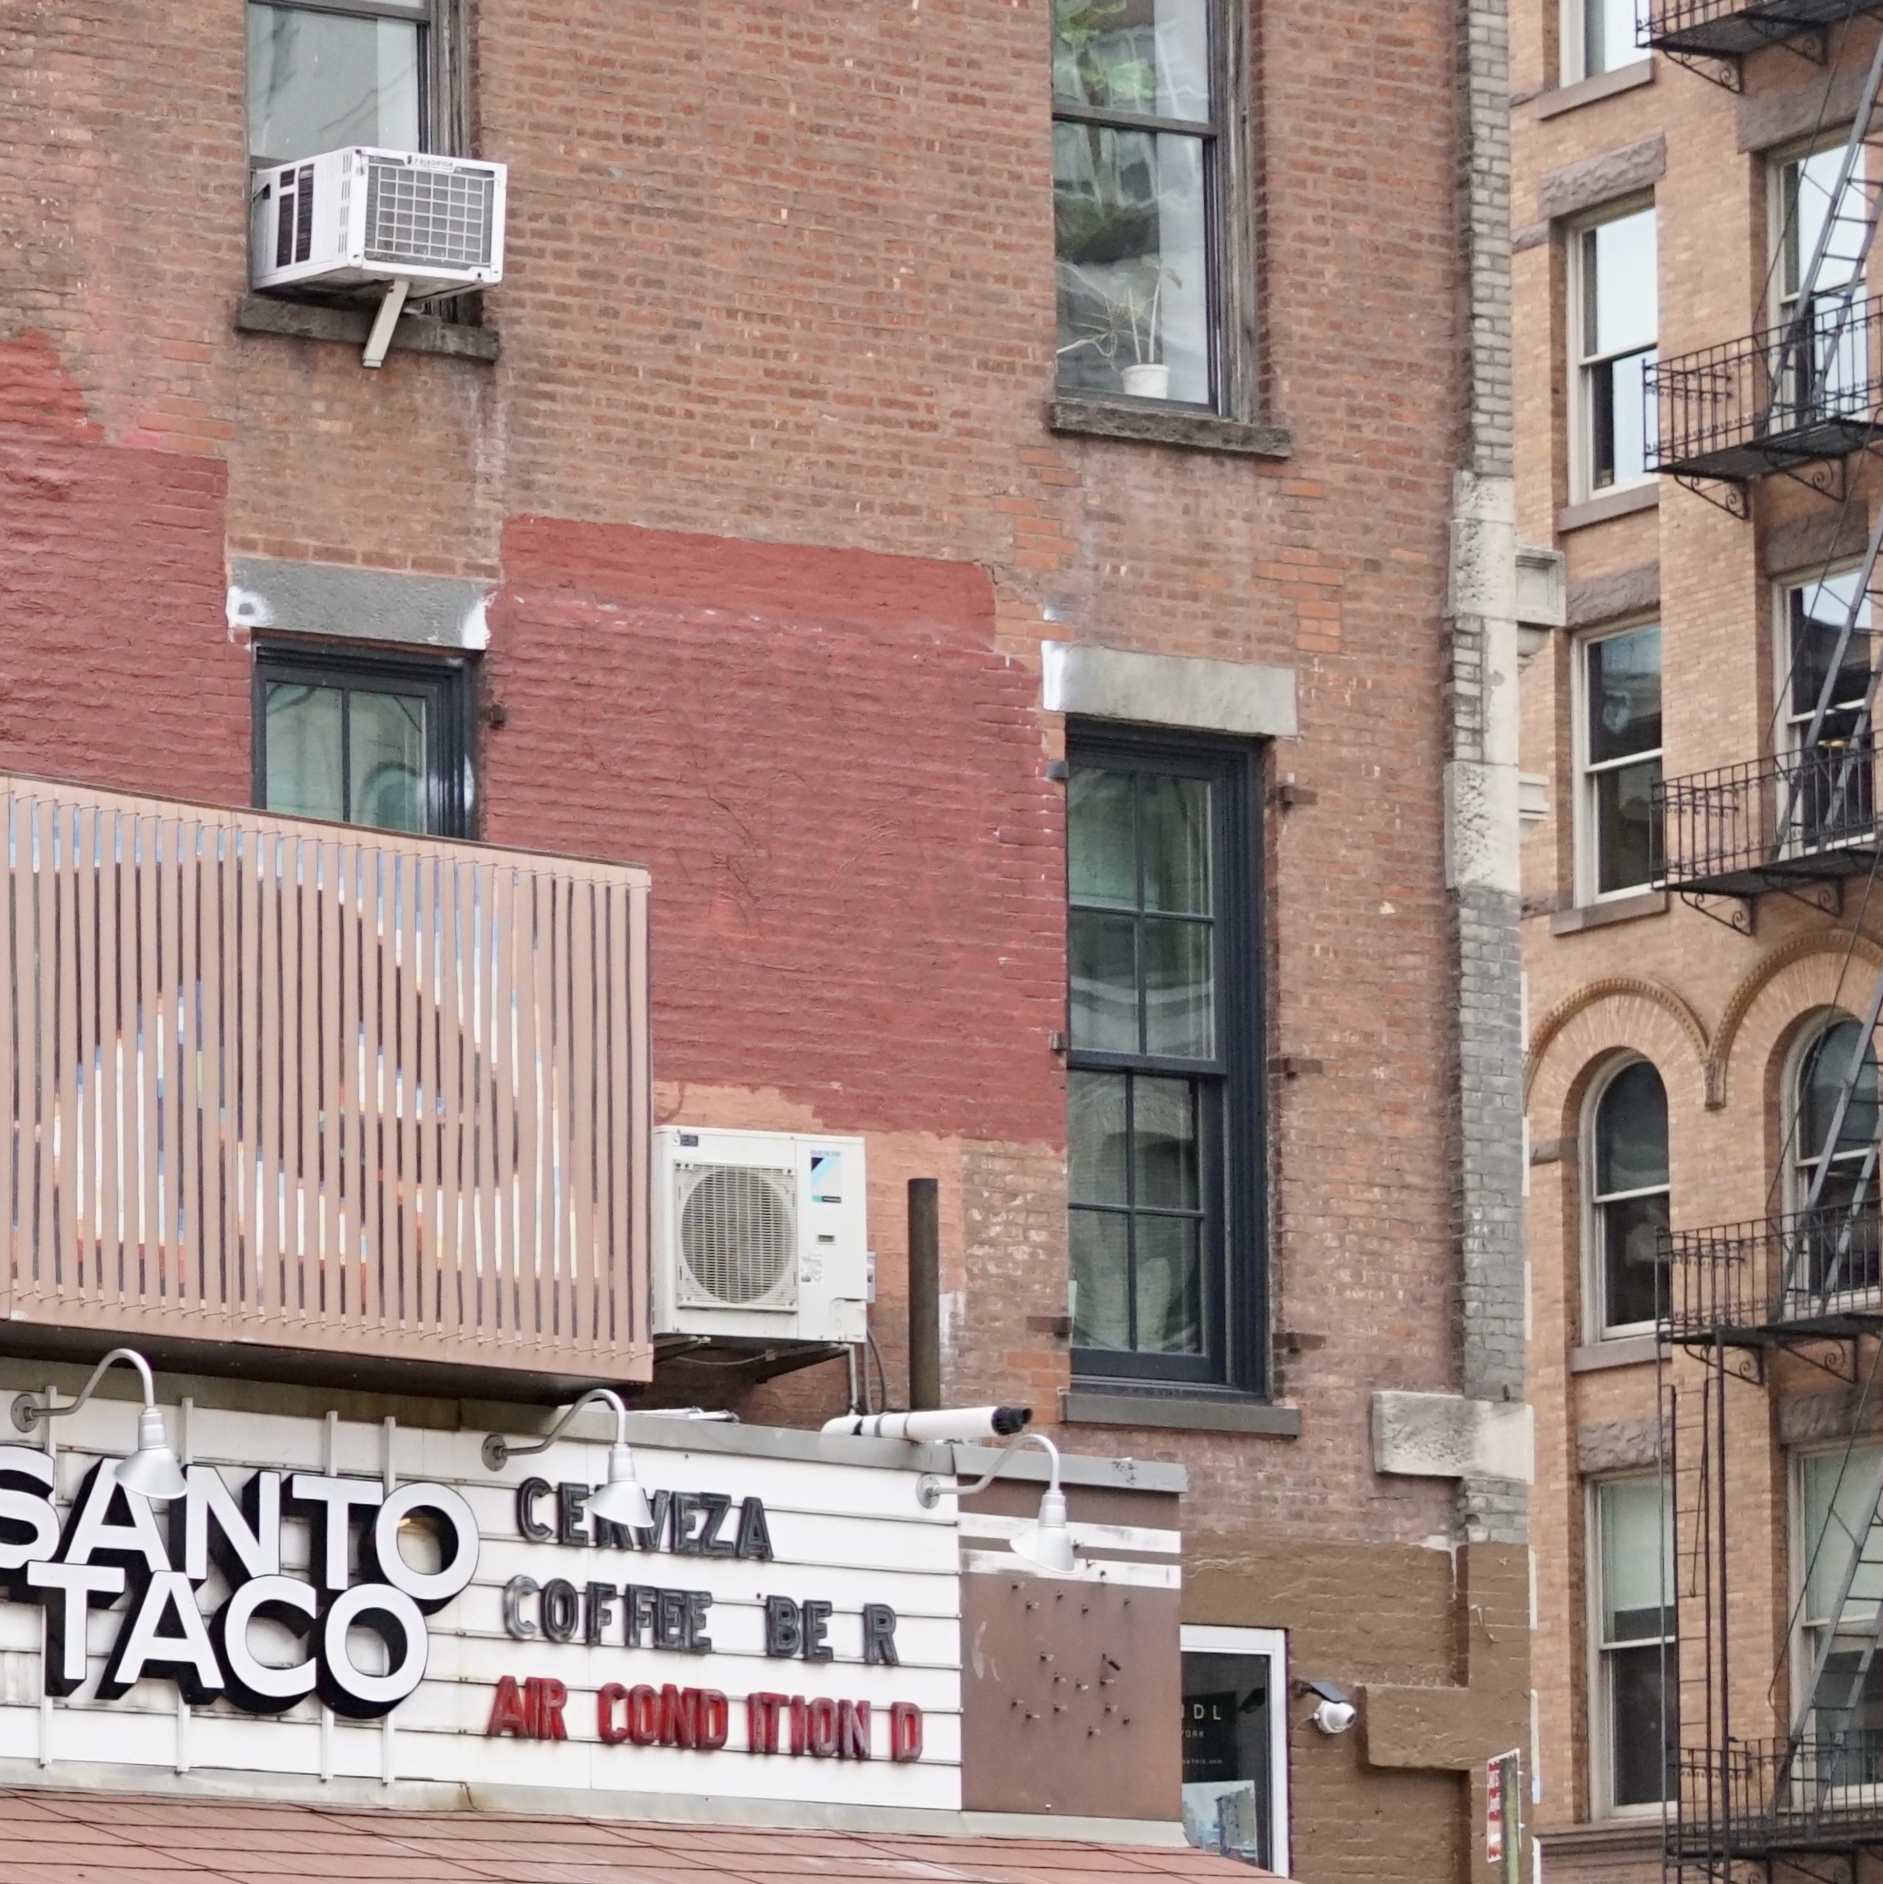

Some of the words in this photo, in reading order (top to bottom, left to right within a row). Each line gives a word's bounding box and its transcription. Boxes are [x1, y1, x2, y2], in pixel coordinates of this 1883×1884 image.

[26, 1558, 430, 1704] TACO
[503, 1574, 713, 1655] COFFEE
[487, 1675, 568, 1741] AIR
[1181, 1730, 1205, 1739] ORK
